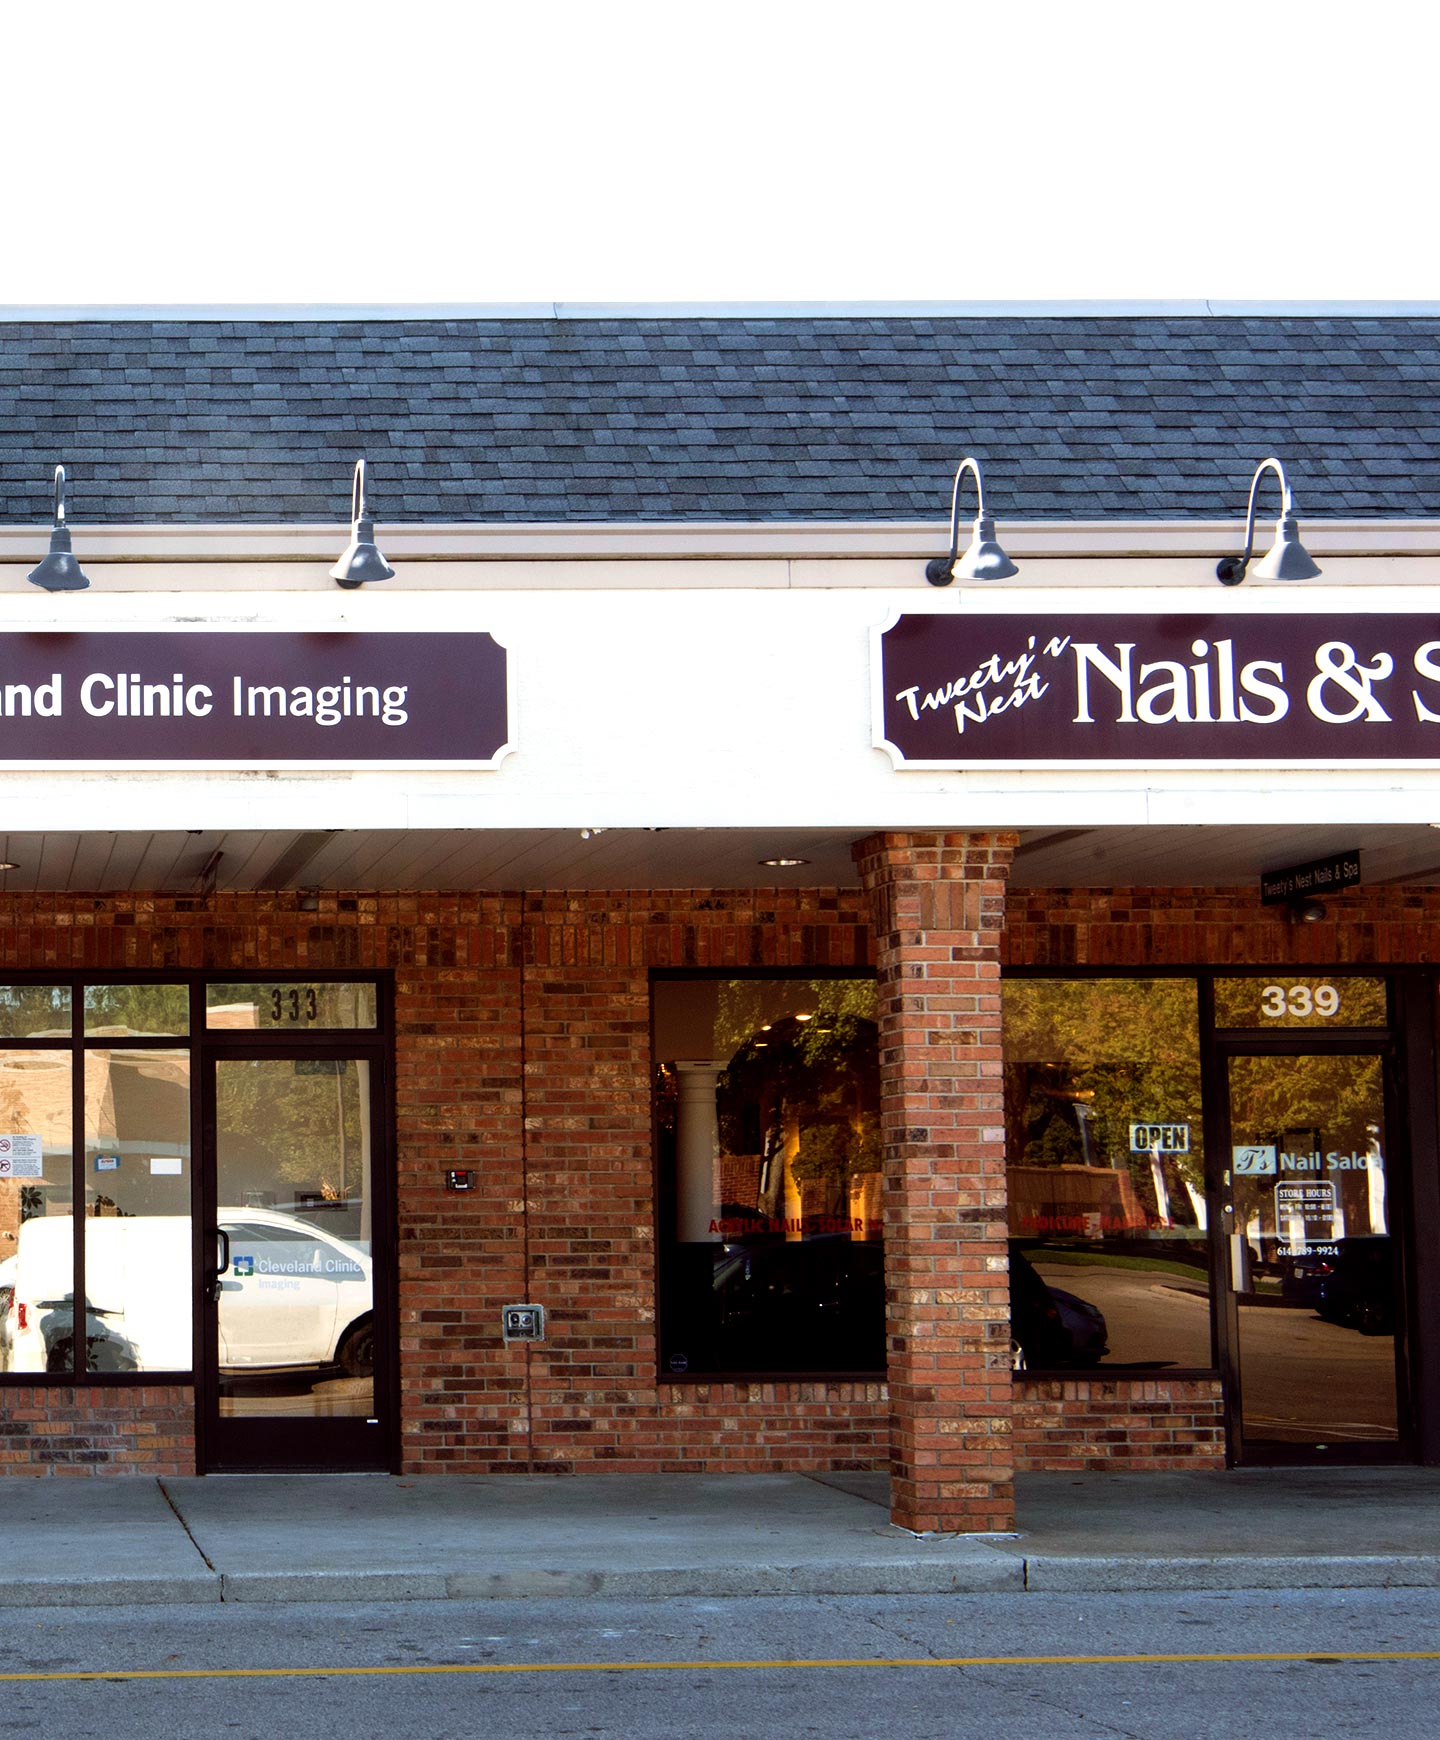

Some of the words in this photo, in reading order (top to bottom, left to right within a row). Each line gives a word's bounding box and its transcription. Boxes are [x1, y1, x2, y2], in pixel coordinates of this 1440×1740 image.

[895, 635, 1071, 721] Tweety's
[1069, 639, 1290, 724] Nails
[1306, 641, 1395, 724] &
[79, 672, 214, 718] Clinic
[232, 675, 409, 727] Imaging
[953, 672, 1050, 735] Nest
[1263, 876, 1294, 897] Tweety's
[1295, 872, 1313, 889] Nest
[1314, 865, 1333, 885] Nails
[1334, 864, 1342, 880] &
[1343, 861, 1359, 880] Spa
[271, 989, 317, 1021] 333
[1261, 985, 1340, 1017] 339
[1134, 1126, 1186, 1150] OPEN
[1280, 1152, 1321, 1171] Nail
[1279, 1188, 1304, 1198] STORE
[1306, 1188, 1332, 1198] HOURS
[258, 1258, 321, 1273] Cleveland
[324, 1259, 362, 1273] Clinic
[258, 1279, 301, 1291] Imaging
